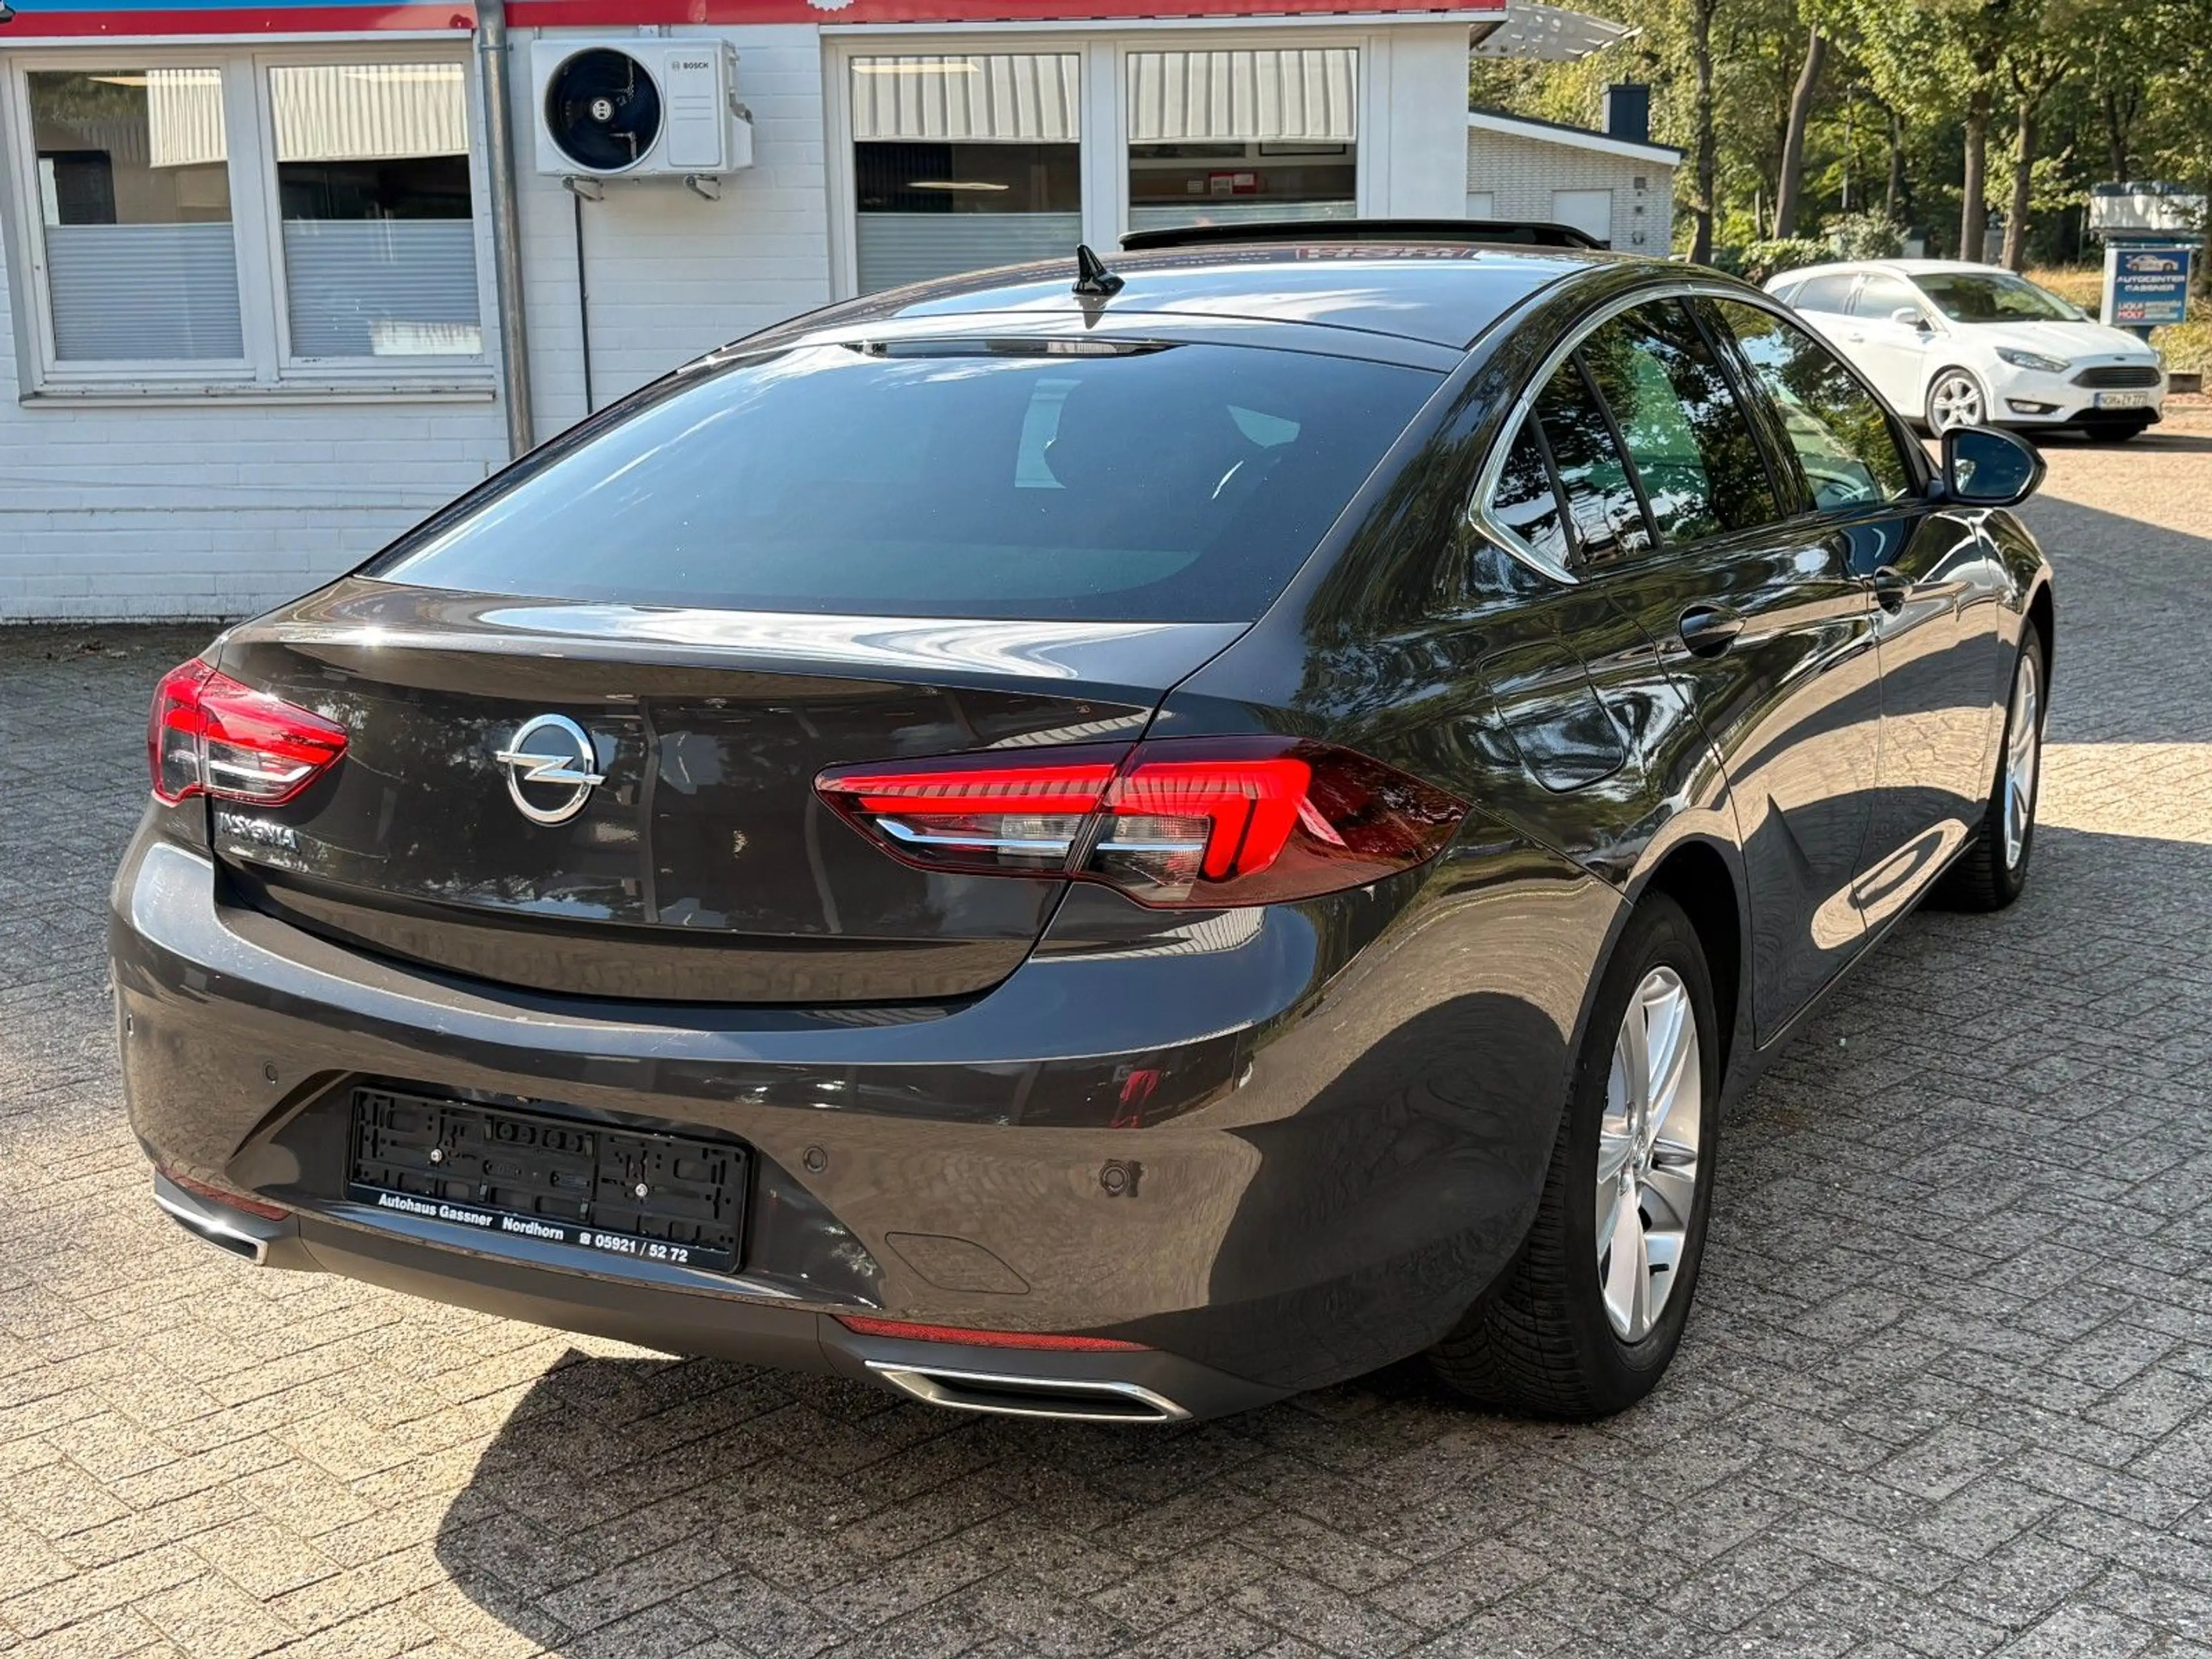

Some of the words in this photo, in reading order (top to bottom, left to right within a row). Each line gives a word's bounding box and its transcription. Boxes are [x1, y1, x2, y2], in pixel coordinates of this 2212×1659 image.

[378, 1193, 437, 1216] Autohaus
[439, 1205, 493, 1226] Gassner
[502, 1216, 564, 1240] Nordhorn
[595, 1234, 636, 1253] 05921
[639, 1241, 647, 1256] /
[649, 1244, 667, 1259] 52
[670, 1247, 688, 1263] 72
